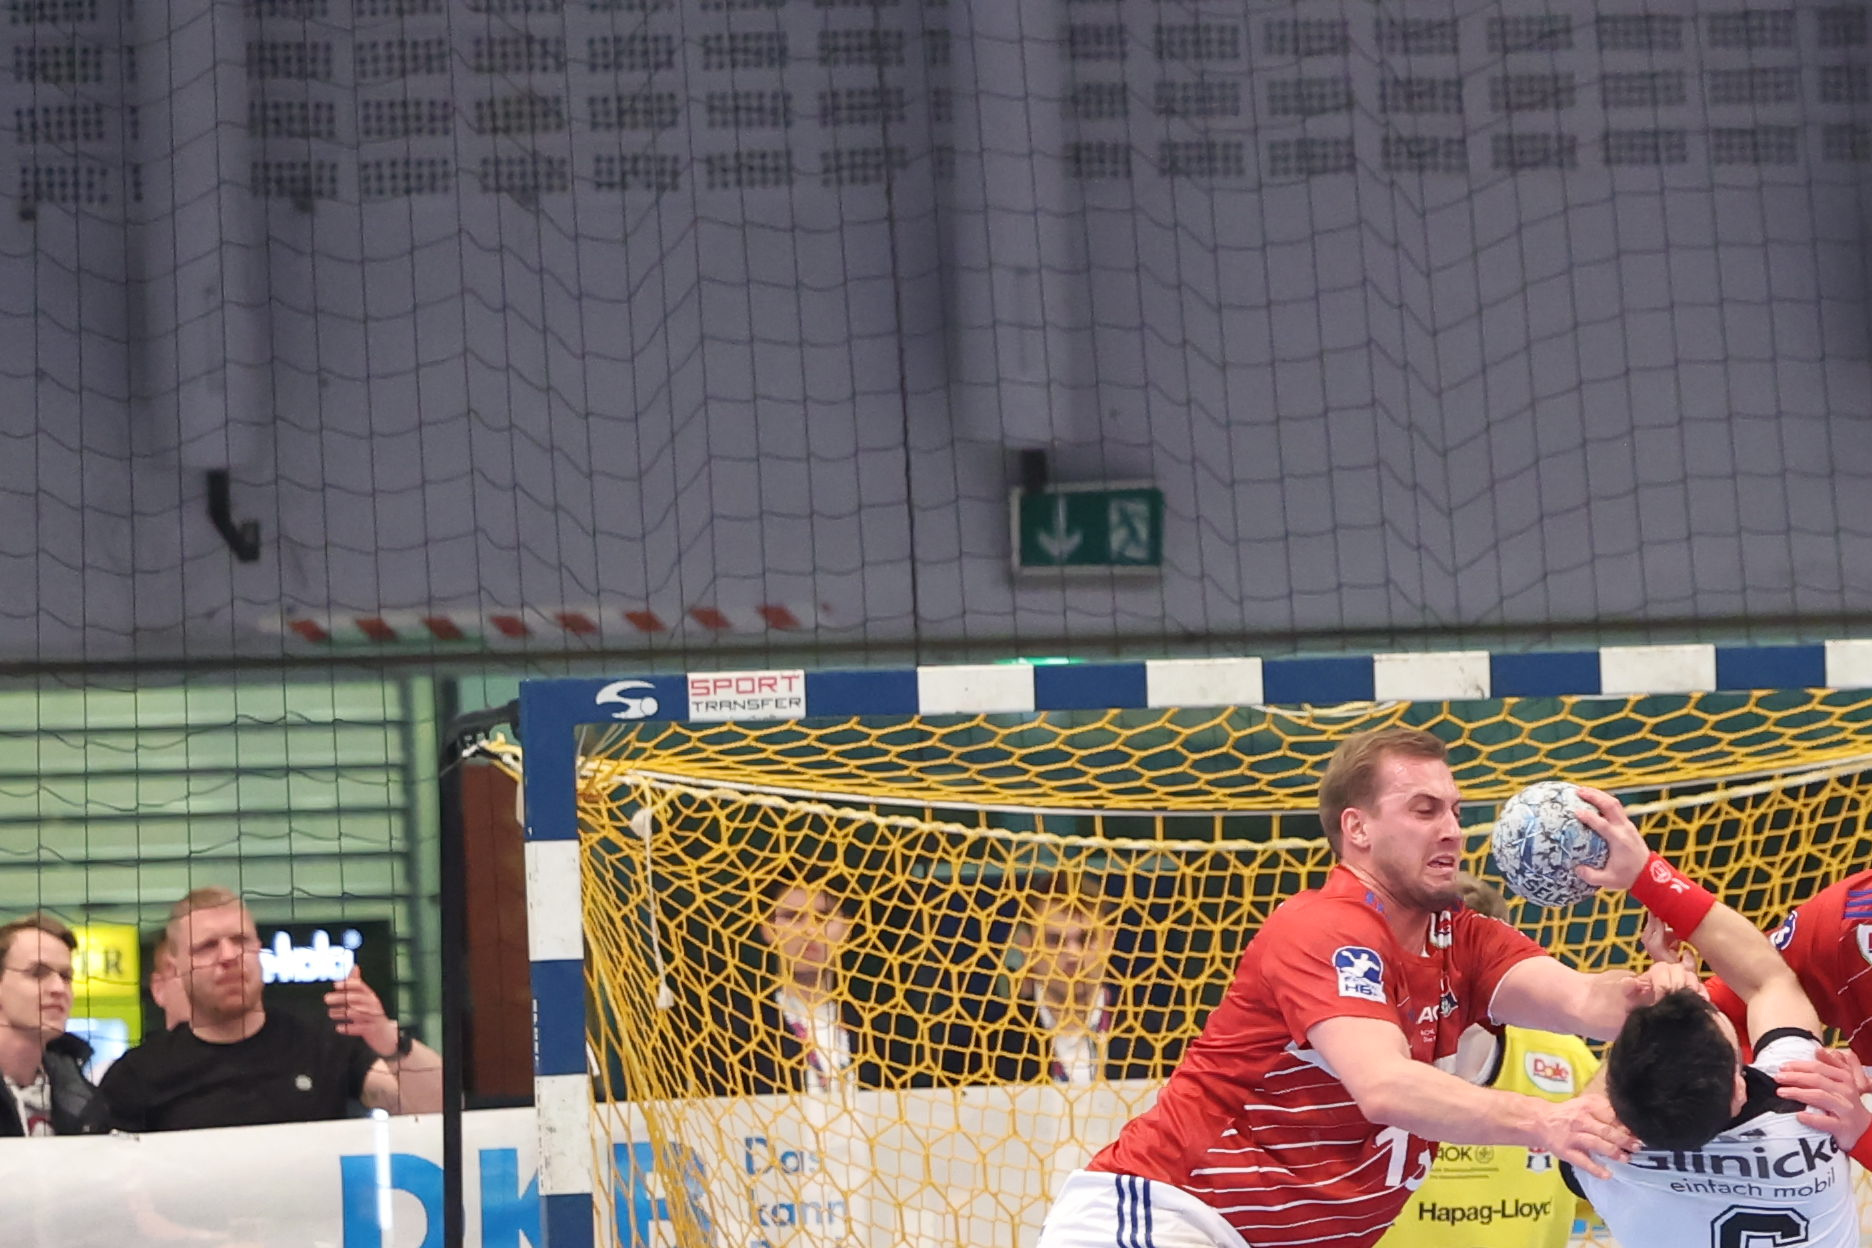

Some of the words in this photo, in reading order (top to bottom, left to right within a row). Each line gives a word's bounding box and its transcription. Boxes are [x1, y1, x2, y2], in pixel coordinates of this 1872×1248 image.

[690, 675, 800, 697] SPORT
[691, 697, 802, 712] TRANSFER
[1533, 1058, 1569, 1080] Dole
[745, 1136, 821, 1176] Das
[1670, 1178, 1762, 1196] einfach
[1774, 1167, 1835, 1198] mobil
